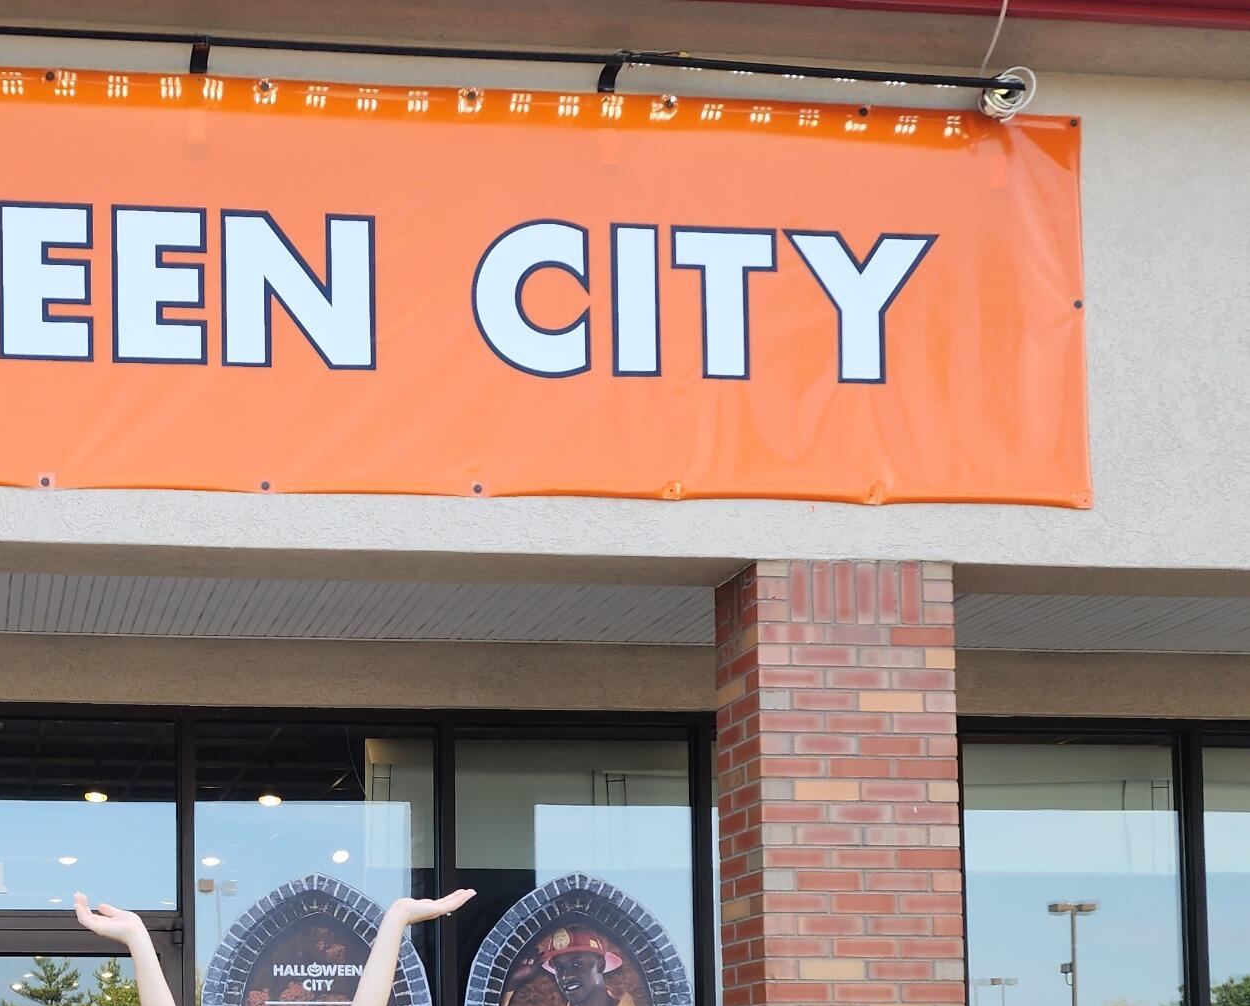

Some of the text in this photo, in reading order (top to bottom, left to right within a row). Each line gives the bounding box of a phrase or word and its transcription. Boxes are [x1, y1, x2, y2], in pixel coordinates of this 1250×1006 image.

[471, 219, 939, 384] CITY
[273, 962, 363, 977] HALLOWEEN
[303, 979, 334, 991] CITY
